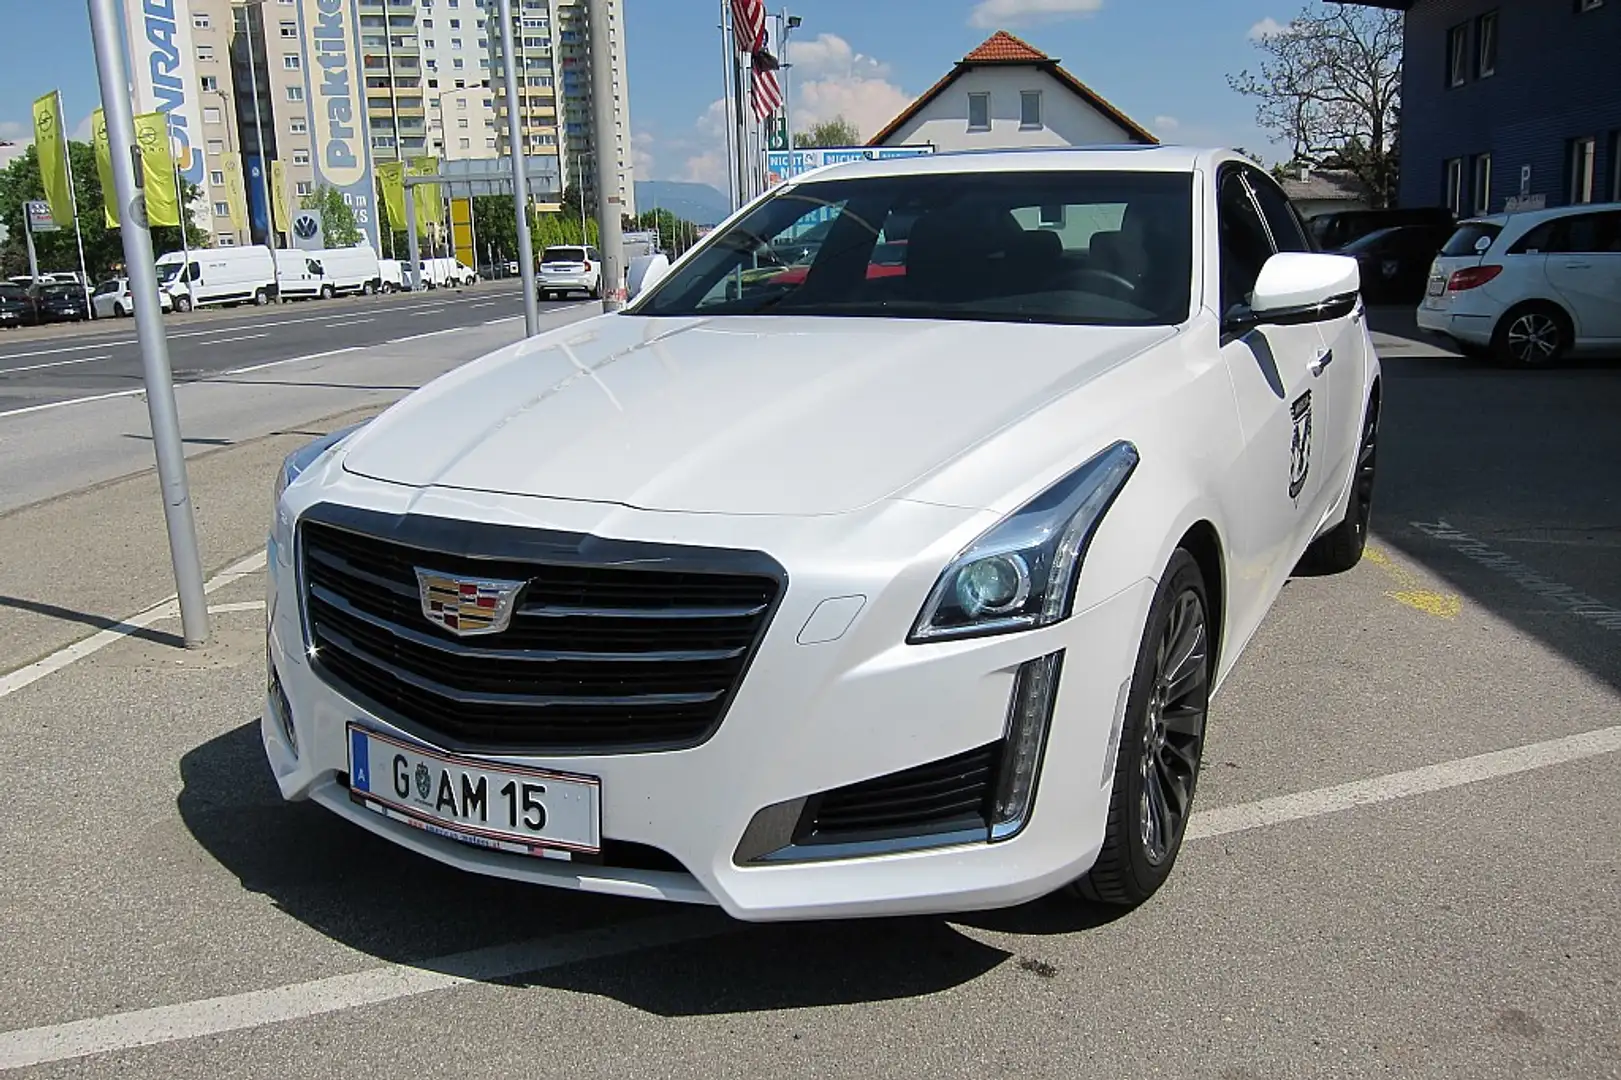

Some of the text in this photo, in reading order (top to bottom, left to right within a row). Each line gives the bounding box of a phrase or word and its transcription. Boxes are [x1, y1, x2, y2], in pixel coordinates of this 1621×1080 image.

[356, 768, 366, 783] A
[392, 753, 548, 831] G AM 15
